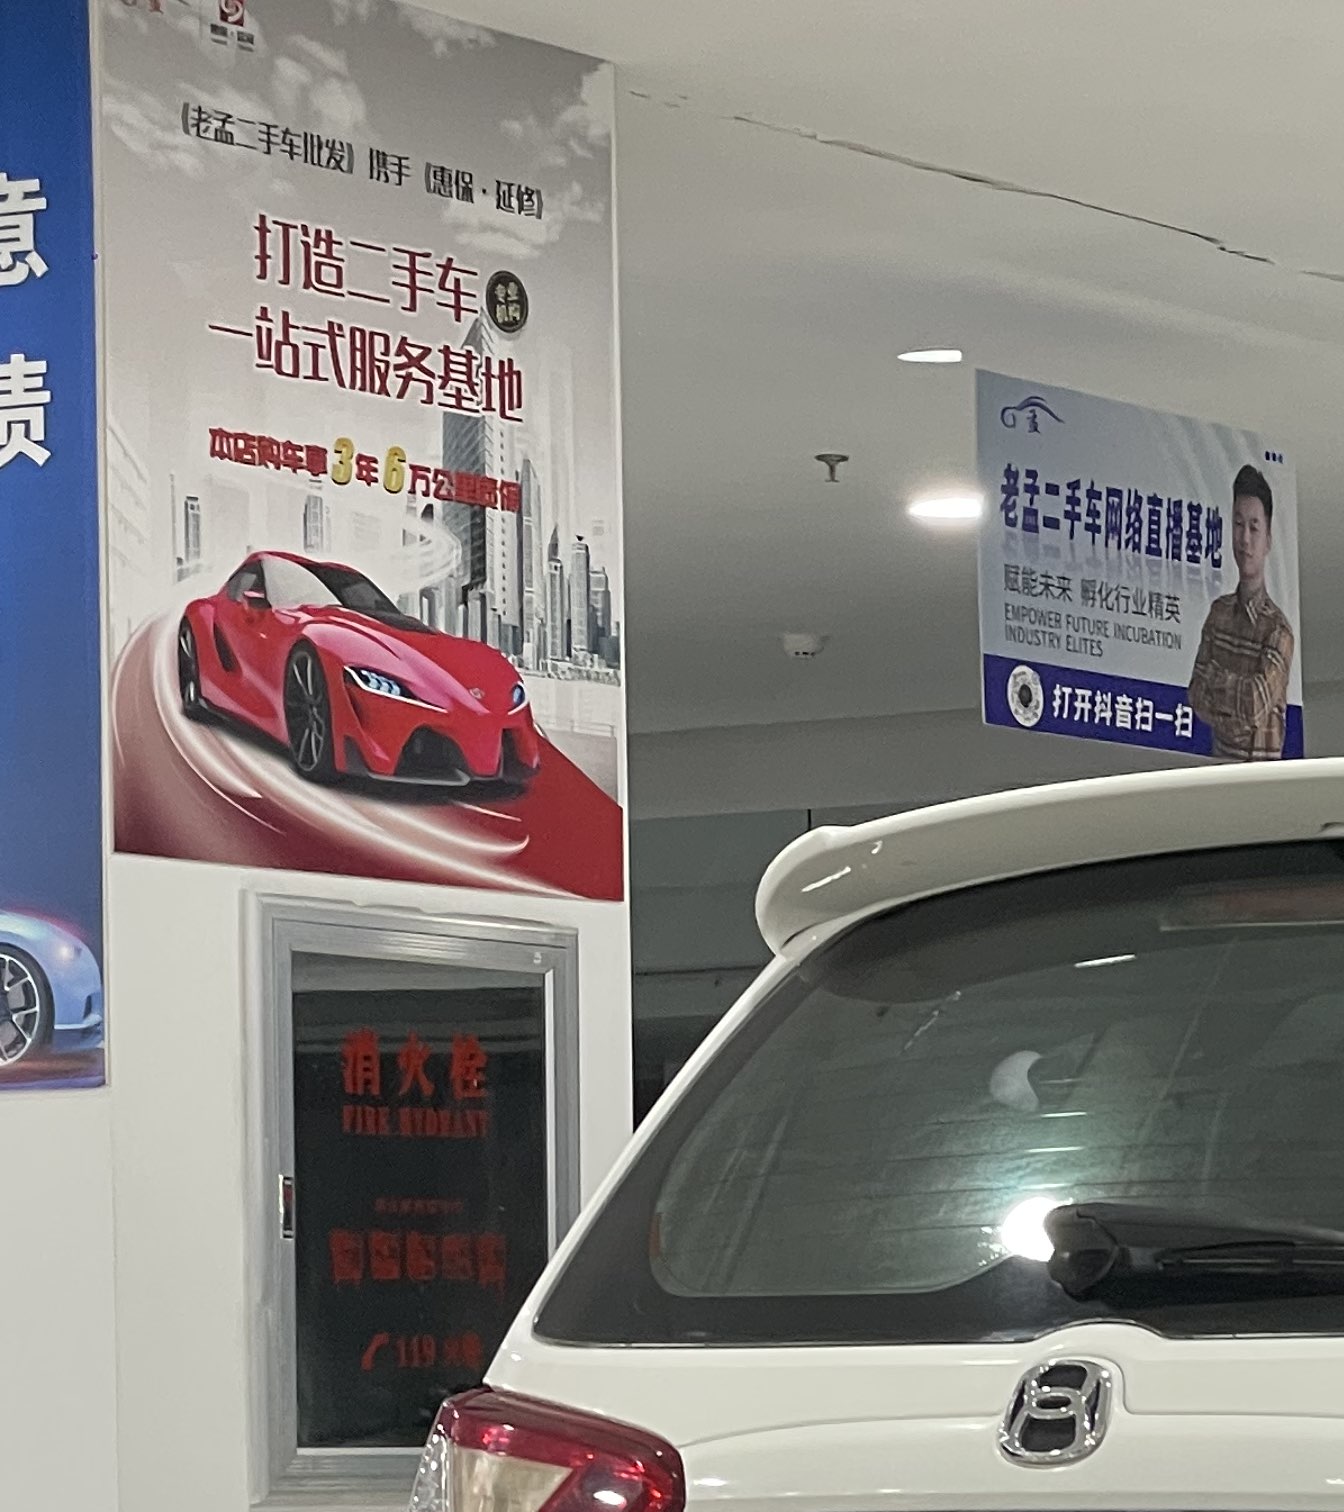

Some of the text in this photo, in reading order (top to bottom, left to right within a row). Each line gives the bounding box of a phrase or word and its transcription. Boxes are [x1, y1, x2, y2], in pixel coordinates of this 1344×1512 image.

[254, 213, 479, 323] 打造二手车
[208, 306, 524, 423] 一站式服务基地
[1000, 463, 1223, 569] 老孟二手车网络直播基地
[1004, 602, 1183, 651] EMPOWER FUTURE INCUBATION
[1004, 624, 1104, 658] INDUSTRY ELITES
[1052, 683, 1194, 739] 打开抖音扫一扫
